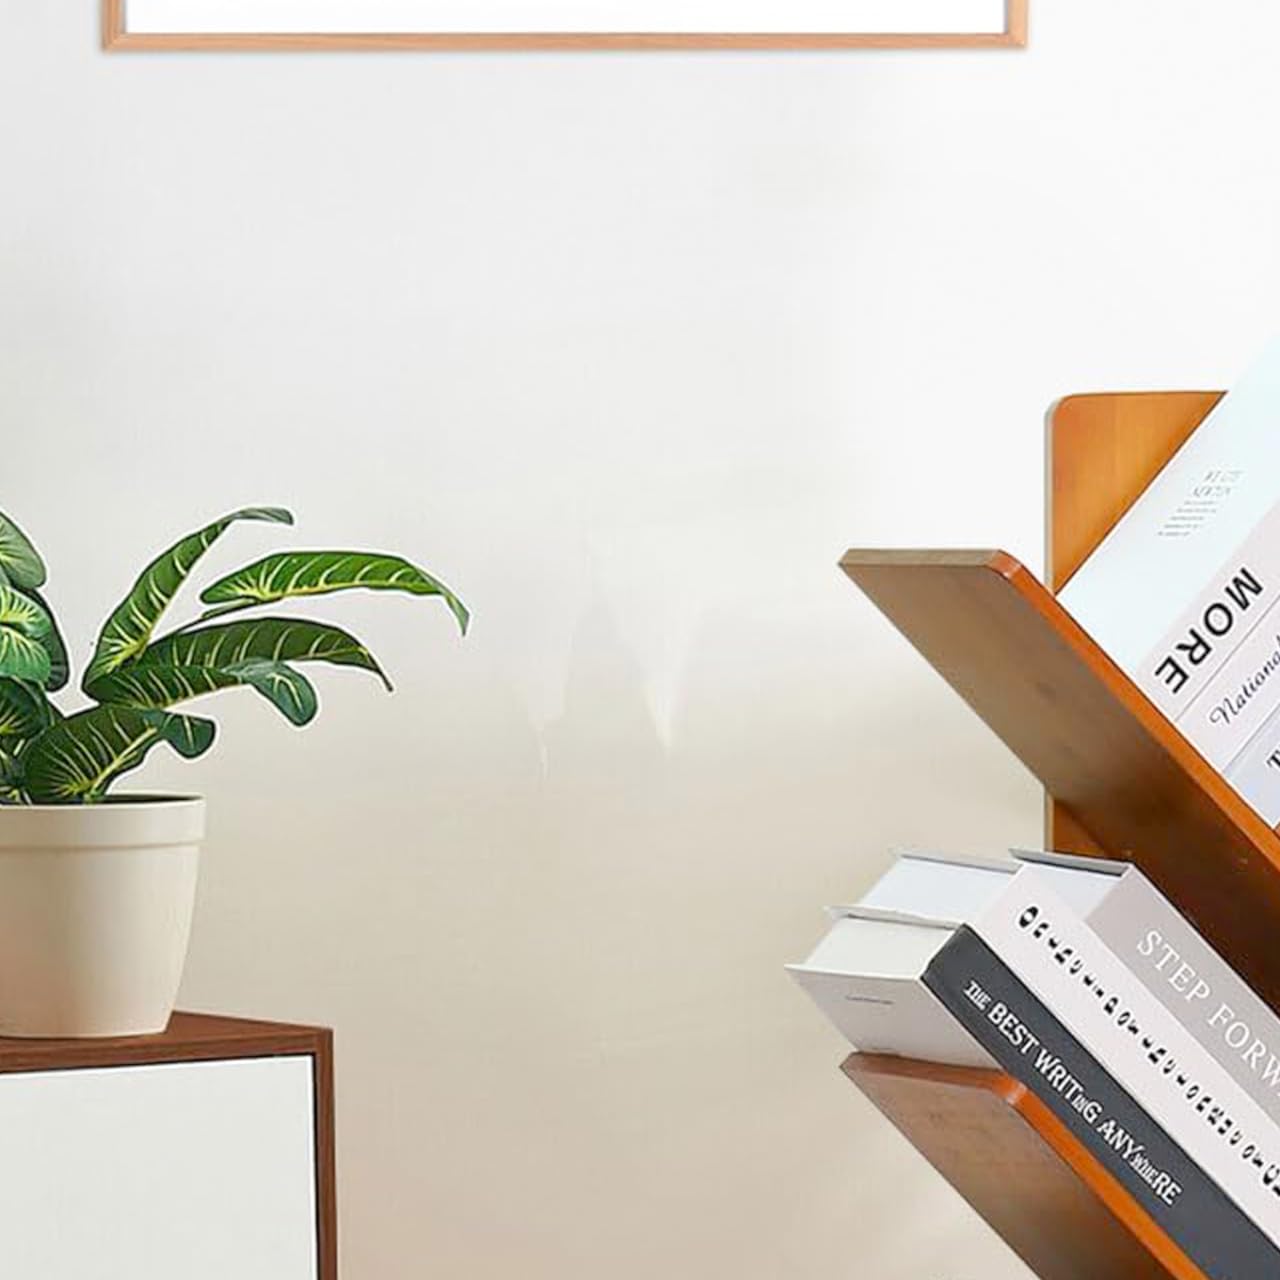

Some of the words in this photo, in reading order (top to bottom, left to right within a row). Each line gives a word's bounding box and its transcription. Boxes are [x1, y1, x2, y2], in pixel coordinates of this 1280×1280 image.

[1154, 567, 1264, 694] MORE
[1136, 929, 1210, 1003] STEP
[963, 980, 995, 1014] THE
[986, 1002, 1042, 1066] BEST
